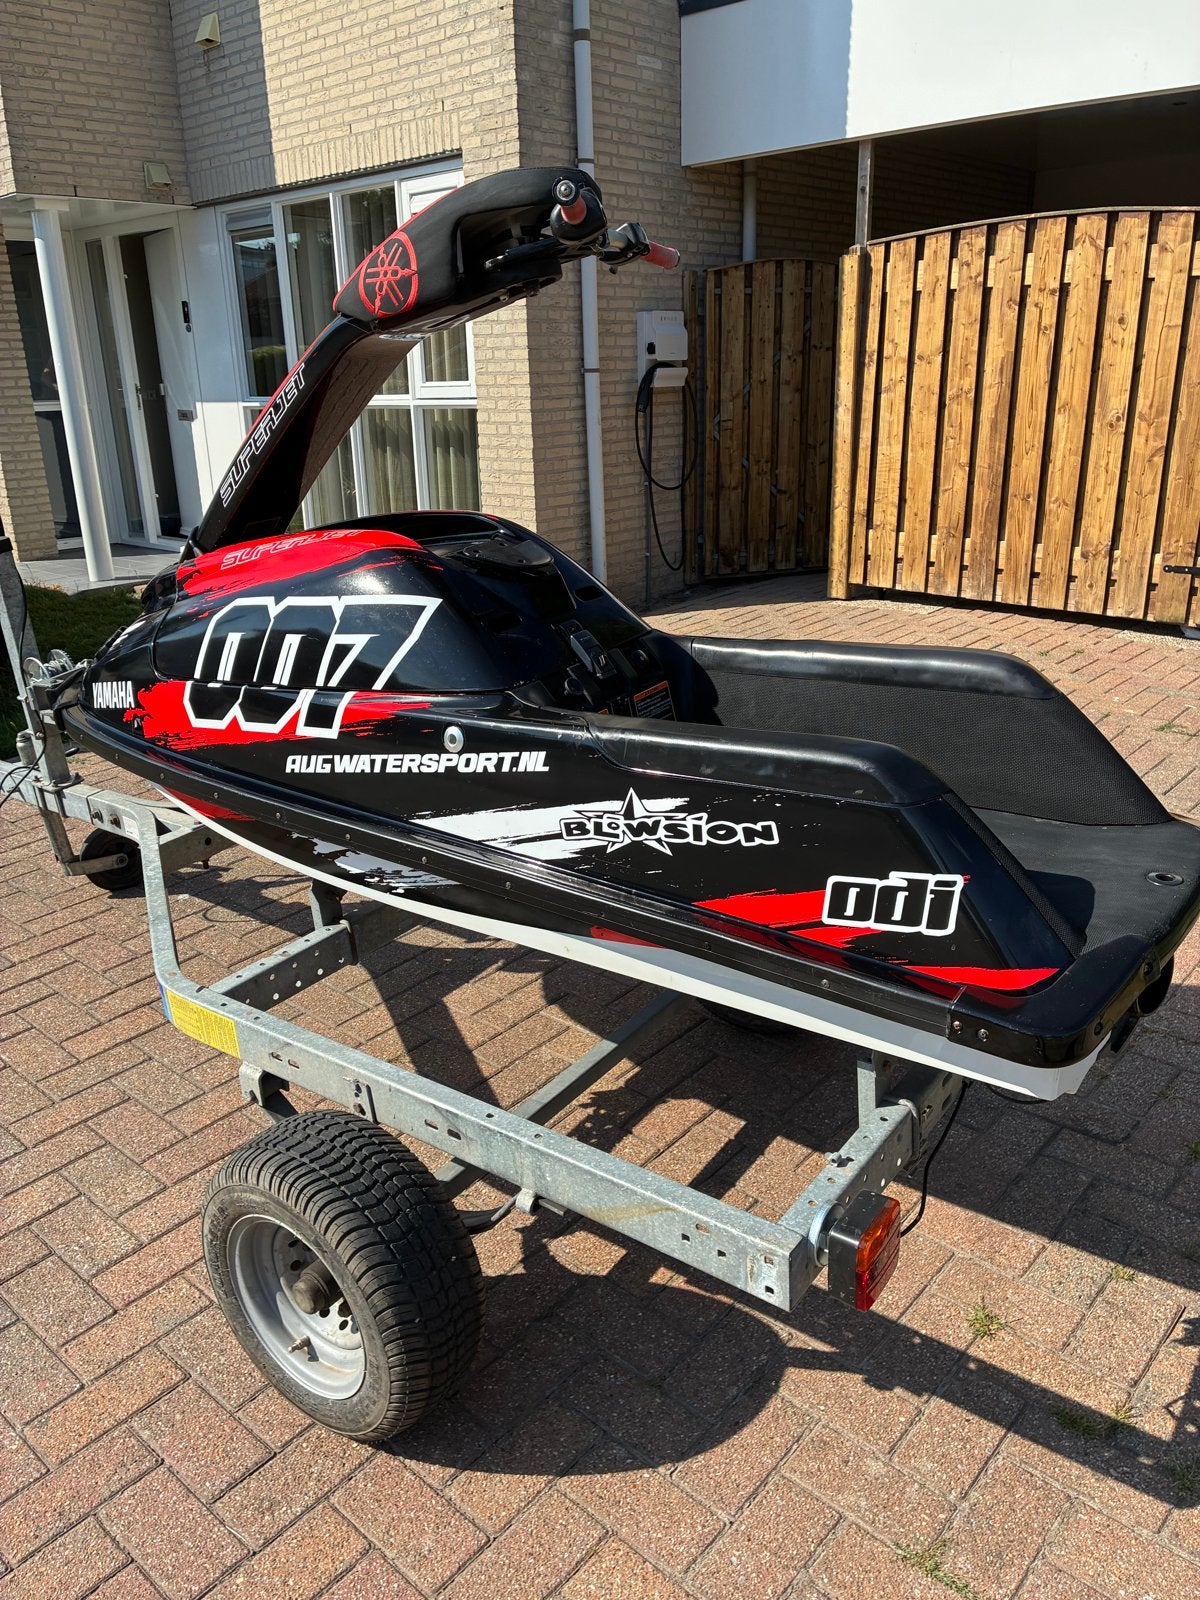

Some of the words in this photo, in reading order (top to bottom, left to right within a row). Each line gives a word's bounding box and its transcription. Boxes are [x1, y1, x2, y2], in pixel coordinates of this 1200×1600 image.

[220, 362, 306, 508] SUPERJET
[92, 681, 135, 709] YAMAHA
[285, 751, 550, 774] AUGWATERSPORT.NL
